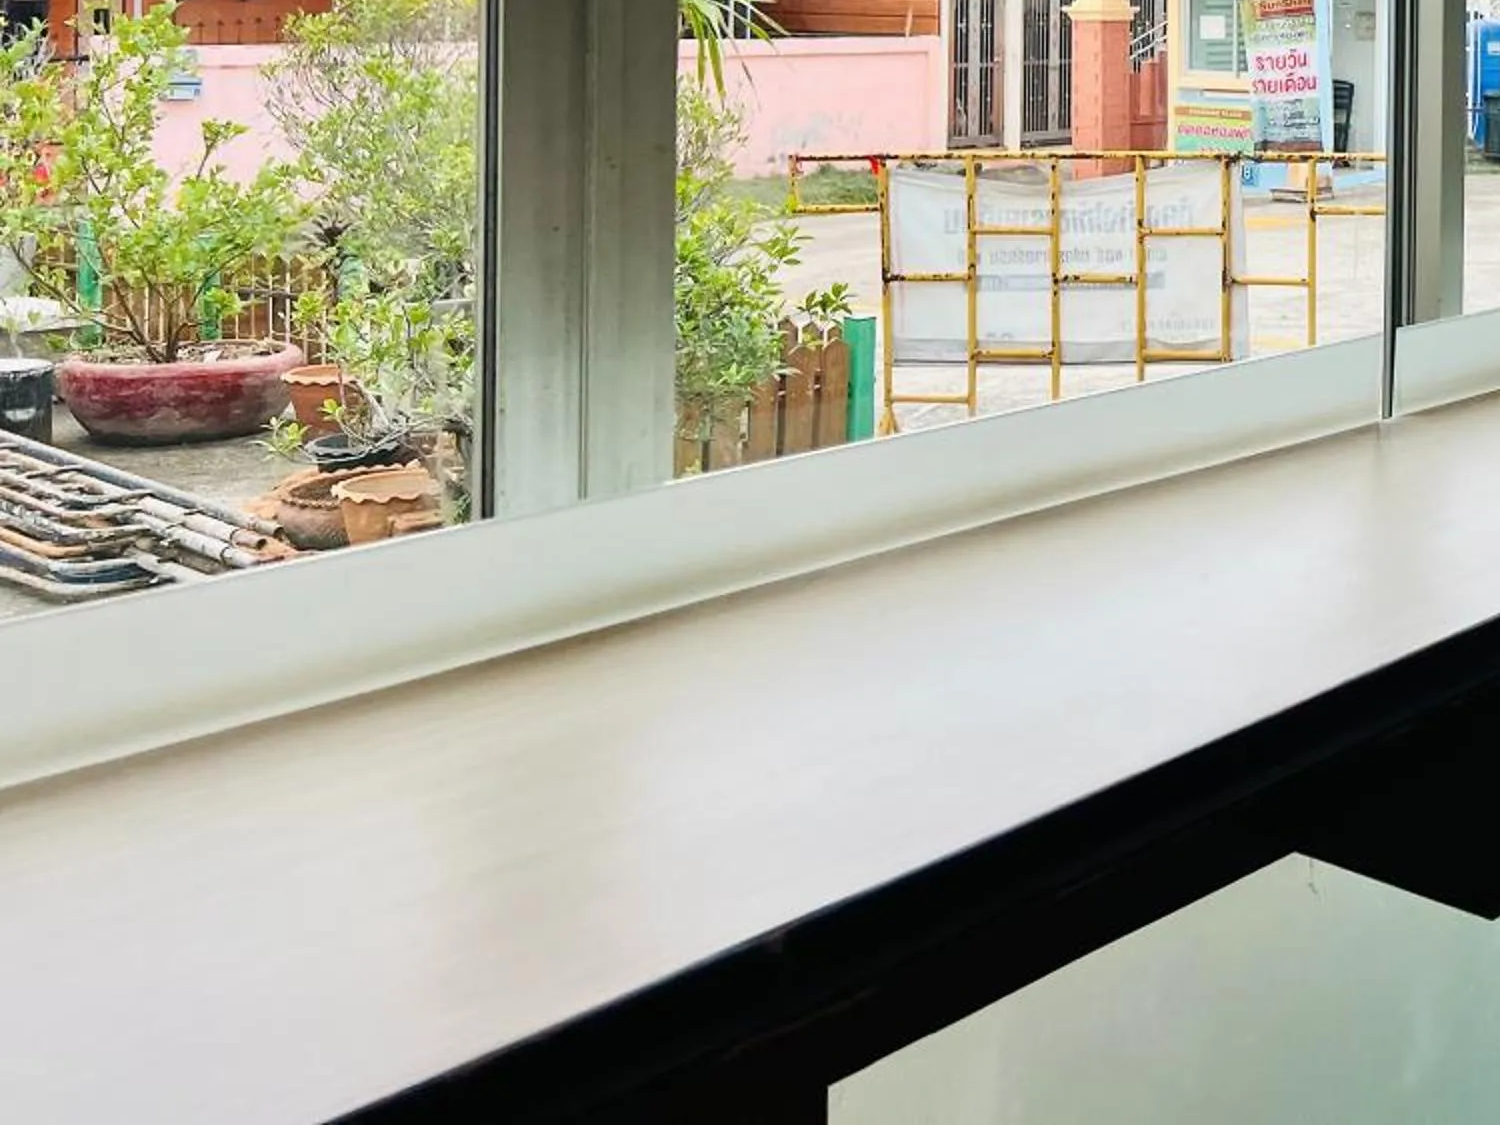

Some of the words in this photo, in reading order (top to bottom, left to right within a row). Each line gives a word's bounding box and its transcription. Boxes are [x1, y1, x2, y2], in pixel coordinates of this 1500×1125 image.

[1255, 48, 1307, 71] รายวัน
[1252, 72, 1317, 93] รายเดือน
